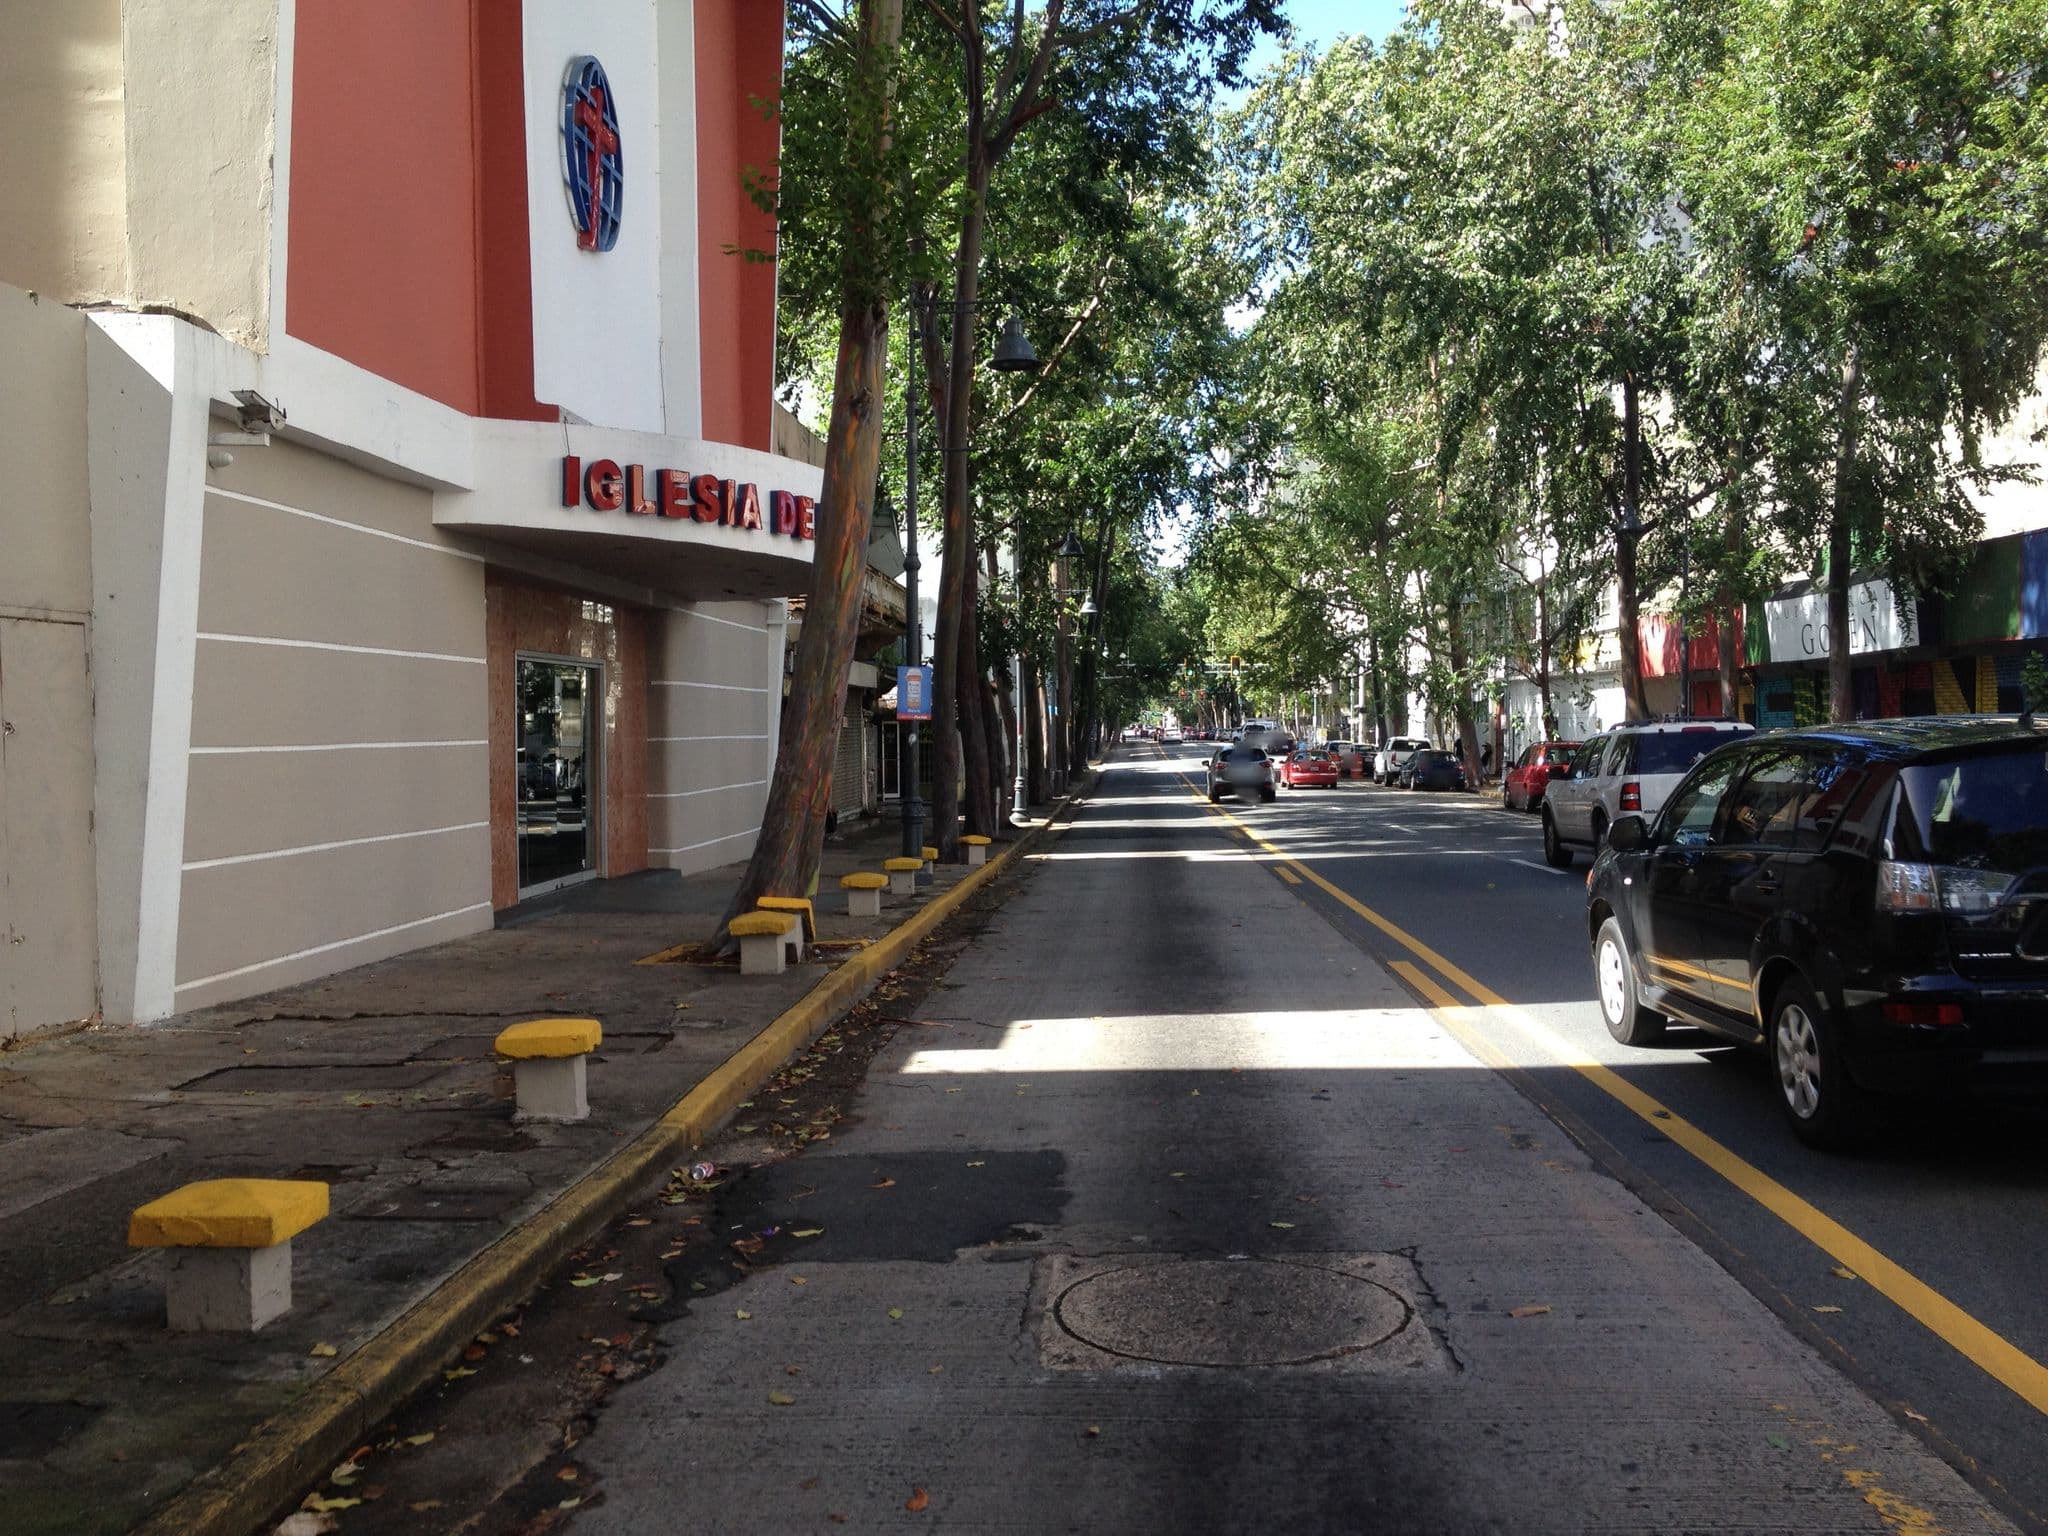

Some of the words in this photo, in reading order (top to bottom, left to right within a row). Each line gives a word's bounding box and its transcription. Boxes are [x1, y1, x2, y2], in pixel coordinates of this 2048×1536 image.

[562, 455, 763, 531] IGLESIA
[769, 489, 821, 541] DE
[1801, 612, 1877, 654] GOÉN
